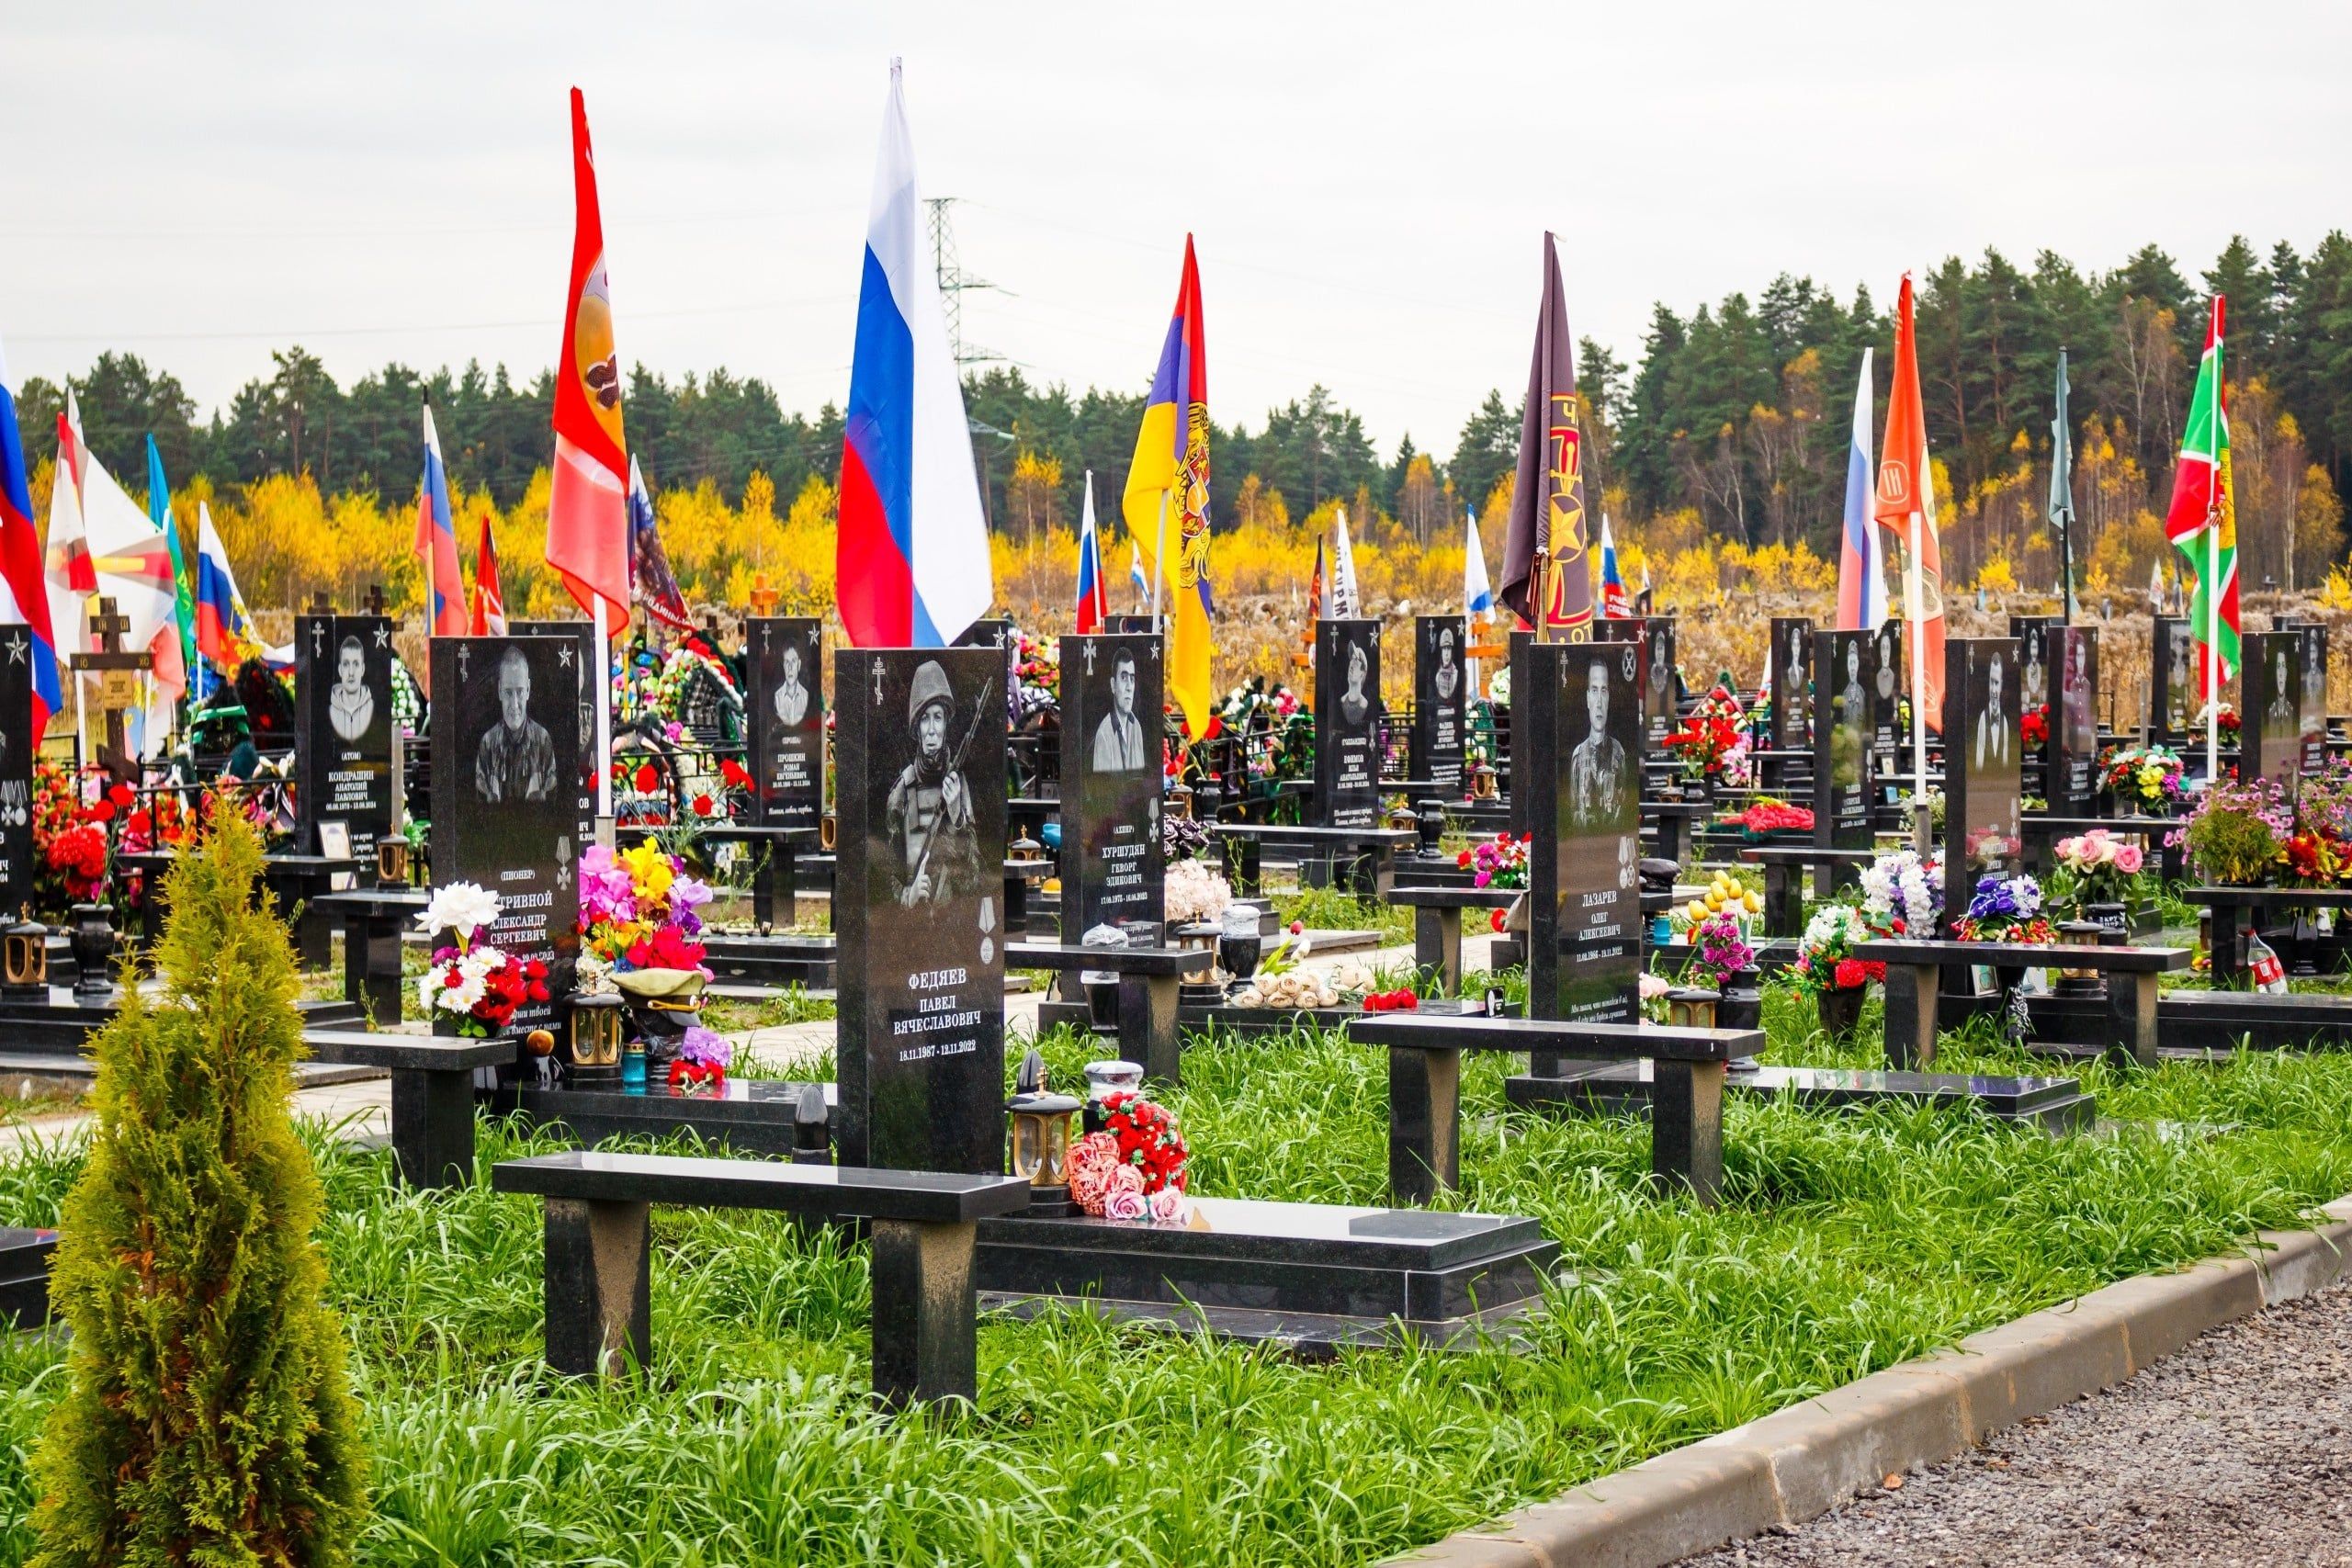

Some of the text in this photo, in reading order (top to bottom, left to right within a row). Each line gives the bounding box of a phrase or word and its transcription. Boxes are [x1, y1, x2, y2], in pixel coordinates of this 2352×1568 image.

[341, 751, 361, 761] (АТОМ)
[777, 752, 806, 763] ПРОШКИН
[328, 771, 374, 783] КОНДРАШИН
[335, 781, 368, 792] АНАТОЛИЙ
[334, 791, 368, 802] ПАВЛОВИЧ
[1102, 843, 1146, 859] ХУРШУДЯН
[1111, 862, 1137, 874] ГЕВОРГ
[501, 870, 535, 881] (ПИОНЕР)
[1105, 874, 1142, 888] ЭДИКОВИЧ
[497, 889, 552, 909] ТРИВНОЙ
[1582, 890, 1617, 908] ЛАЗАРЕВ
[490, 914, 547, 930] АЛЕКСАНДР
[1590, 911, 1609, 924] ОЛЕГ
[490, 930, 547, 944] СЕРГЕЕВИЧ
[1578, 924, 1621, 942] АЛЕКСЕЕВИЧ
[909, 967, 967, 992] ФЕДЯЕВ
[919, 995, 956, 1013] ПАВЕЛ
[529, 1006, 551, 1017] твоей
[544, 1021, 561, 1030] нами
[893, 1010, 981, 1035] ВЯЧЕСЛАВОВИЧ
[899, 1044, 935, 1062] 18.11.1987
[941, 1039, 977, 1055] 12.11.2022
